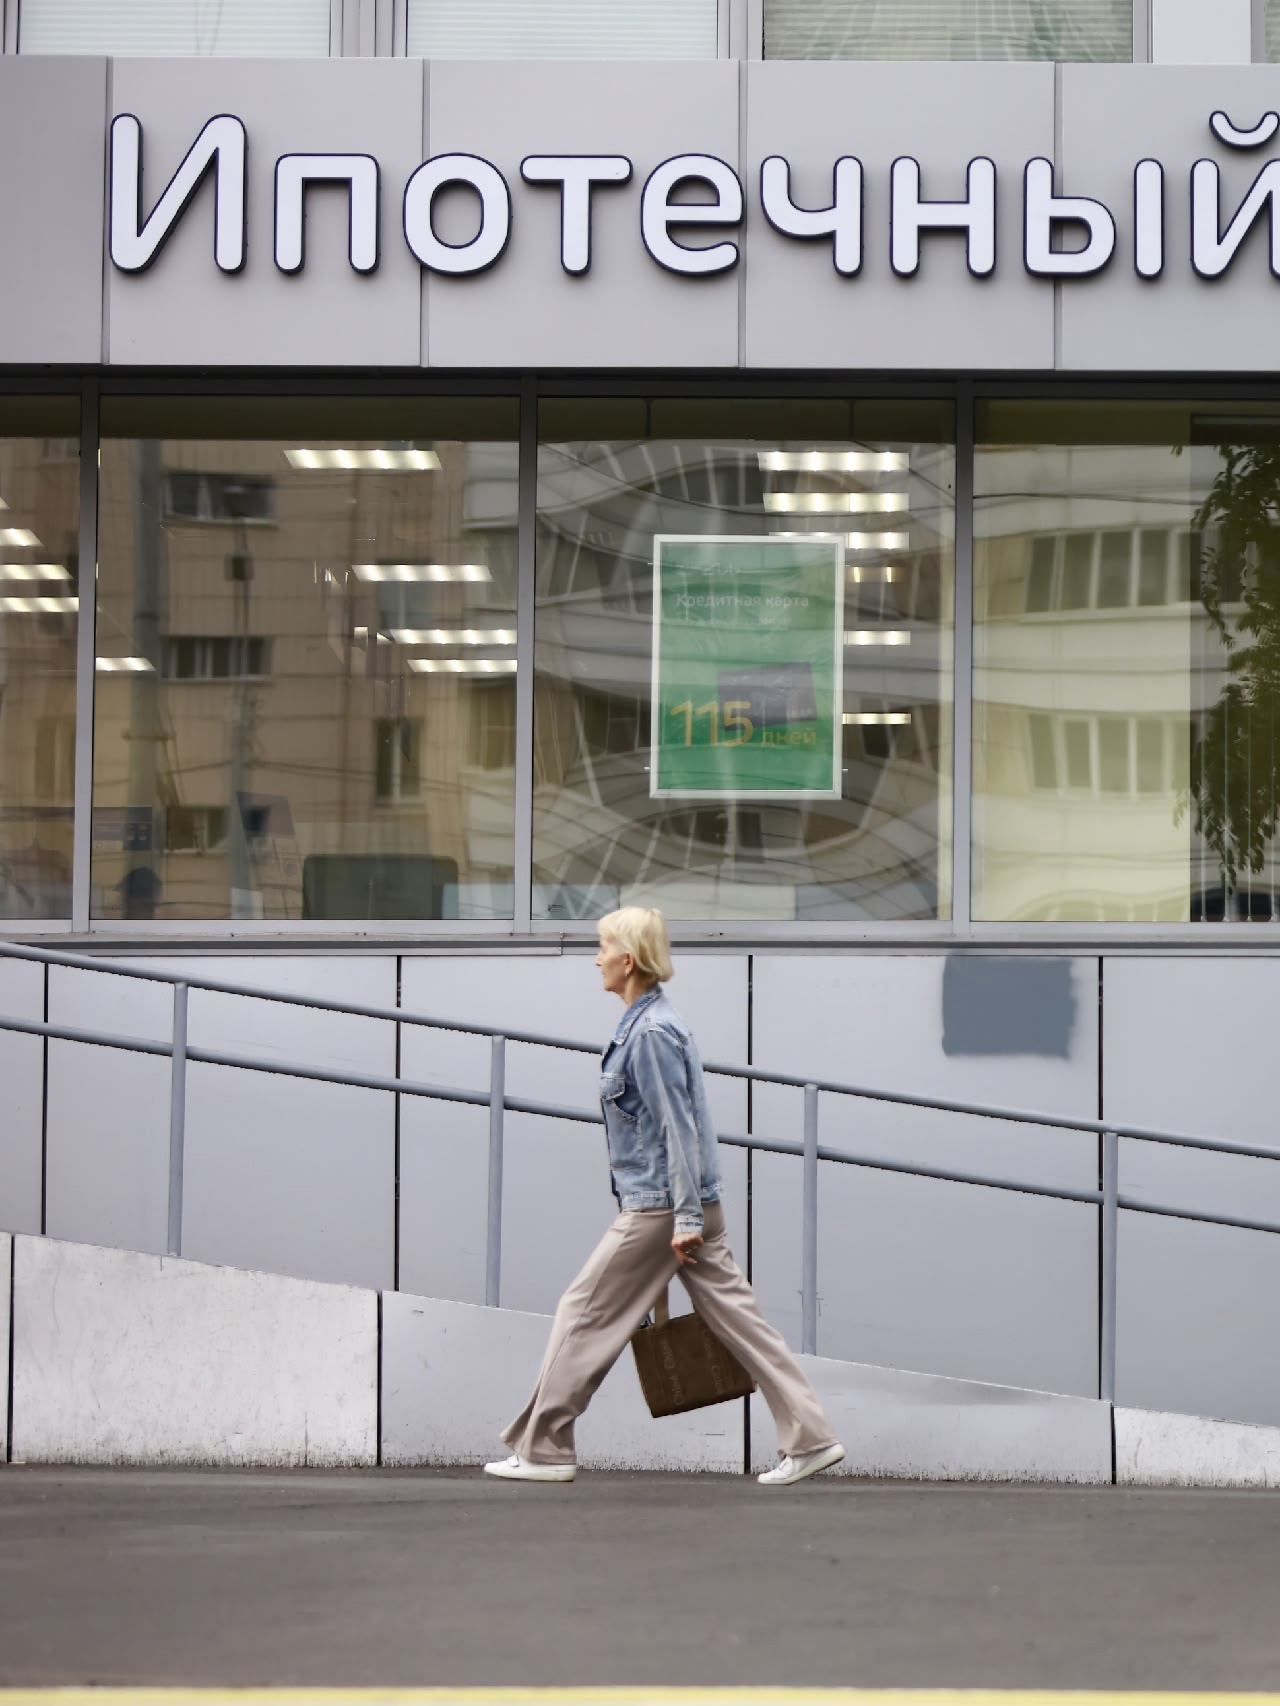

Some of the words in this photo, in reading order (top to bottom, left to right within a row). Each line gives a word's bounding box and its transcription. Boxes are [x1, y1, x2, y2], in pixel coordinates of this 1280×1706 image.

[677, 593, 761, 608] Кредитная
[765, 596, 809, 609] карта
[670, 699, 754, 748] 115
[760, 727, 817, 748] дней
